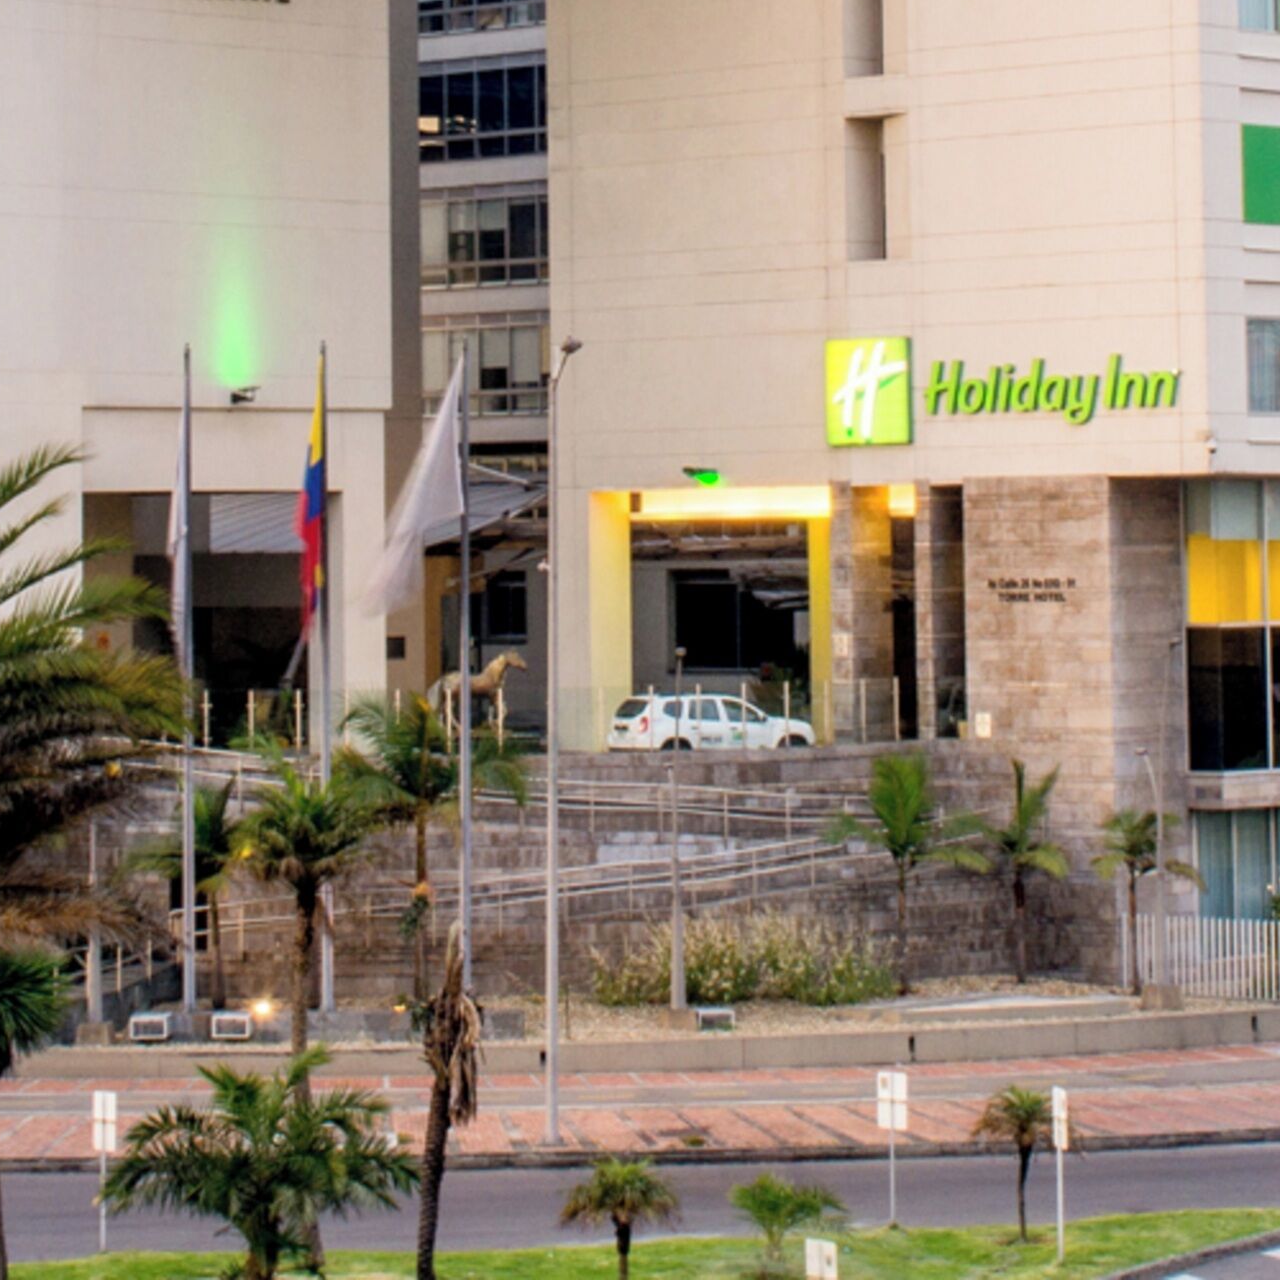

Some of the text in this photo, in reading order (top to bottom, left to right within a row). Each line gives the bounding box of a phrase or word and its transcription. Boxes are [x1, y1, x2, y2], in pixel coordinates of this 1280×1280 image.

[924, 353, 1181, 426] Holiday Inn
[1034, 592, 1067, 603] HOTEL
